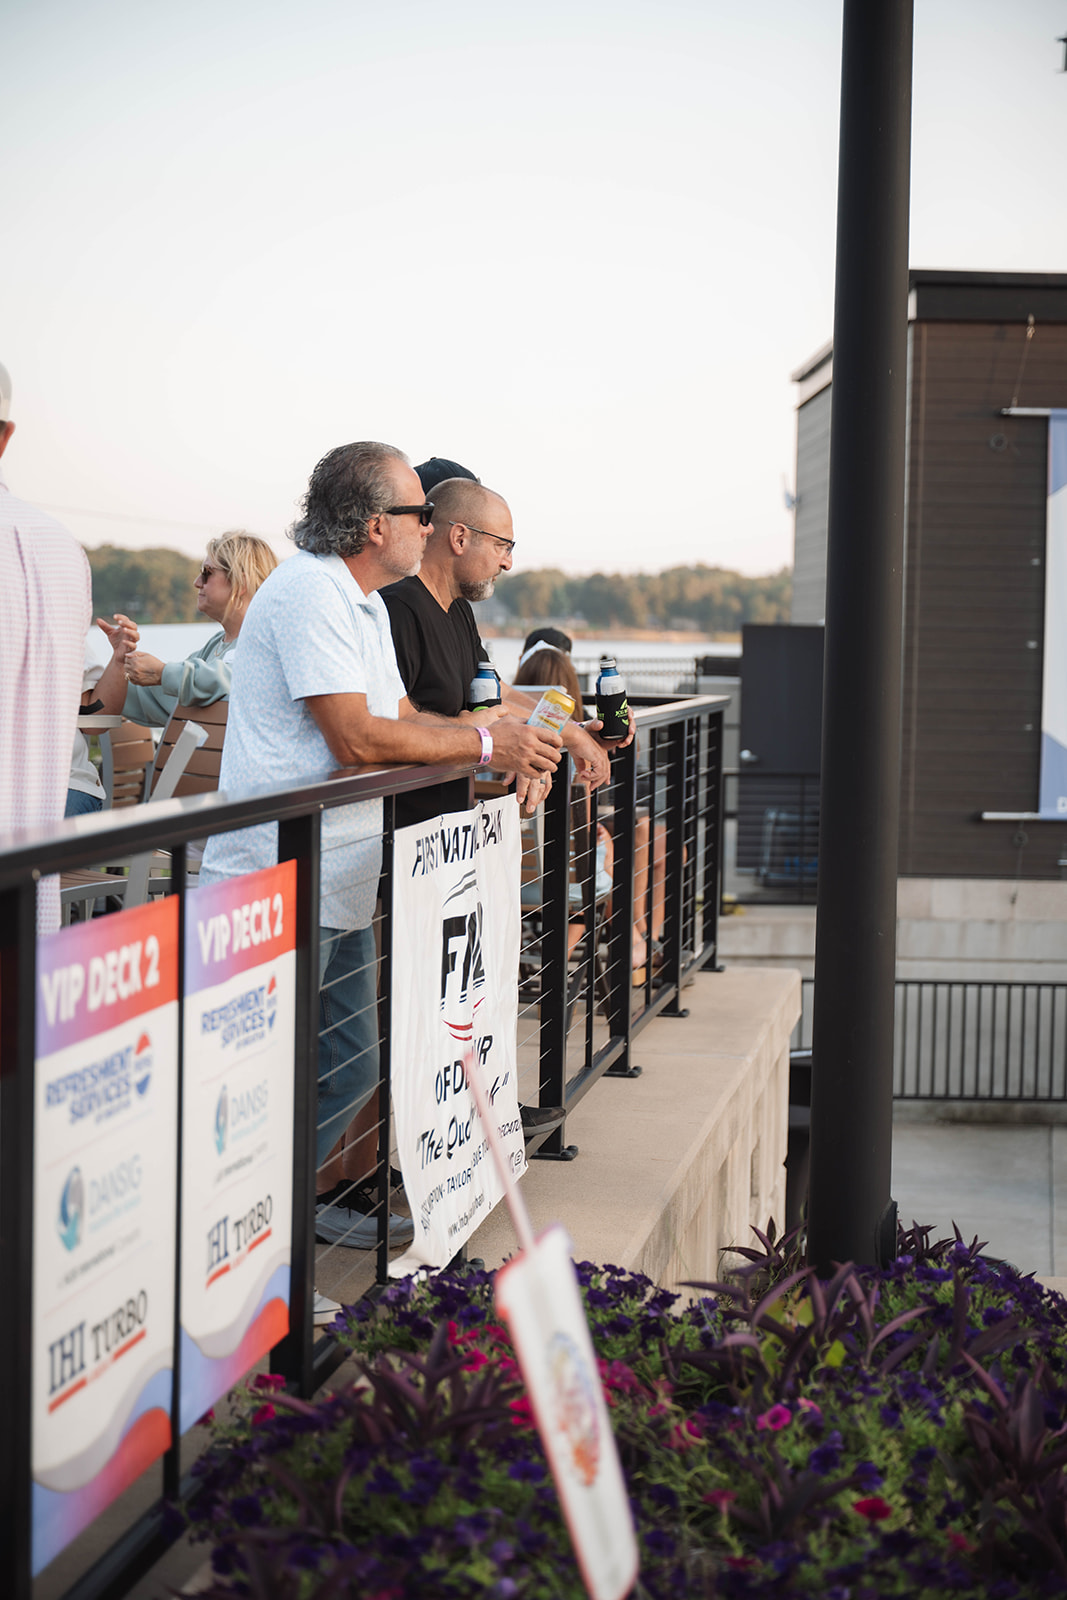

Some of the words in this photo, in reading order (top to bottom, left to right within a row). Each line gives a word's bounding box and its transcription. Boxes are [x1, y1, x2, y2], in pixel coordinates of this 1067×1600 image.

[197, 913, 230, 966] VIP
[231, 897, 272, 955] DECK
[273, 892, 284, 937] 2
[41, 963, 85, 1028] VIP
[87, 940, 142, 1013] DECK
[145, 934, 160, 988] 2
[45, 1045, 133, 1109] REFRESHMENT
[435, 1065, 451, 1106] OF
[233, 1194, 273, 1253] TURBO
[48, 1320, 86, 1395] IHI
[91, 1289, 148, 1363] TURBO
